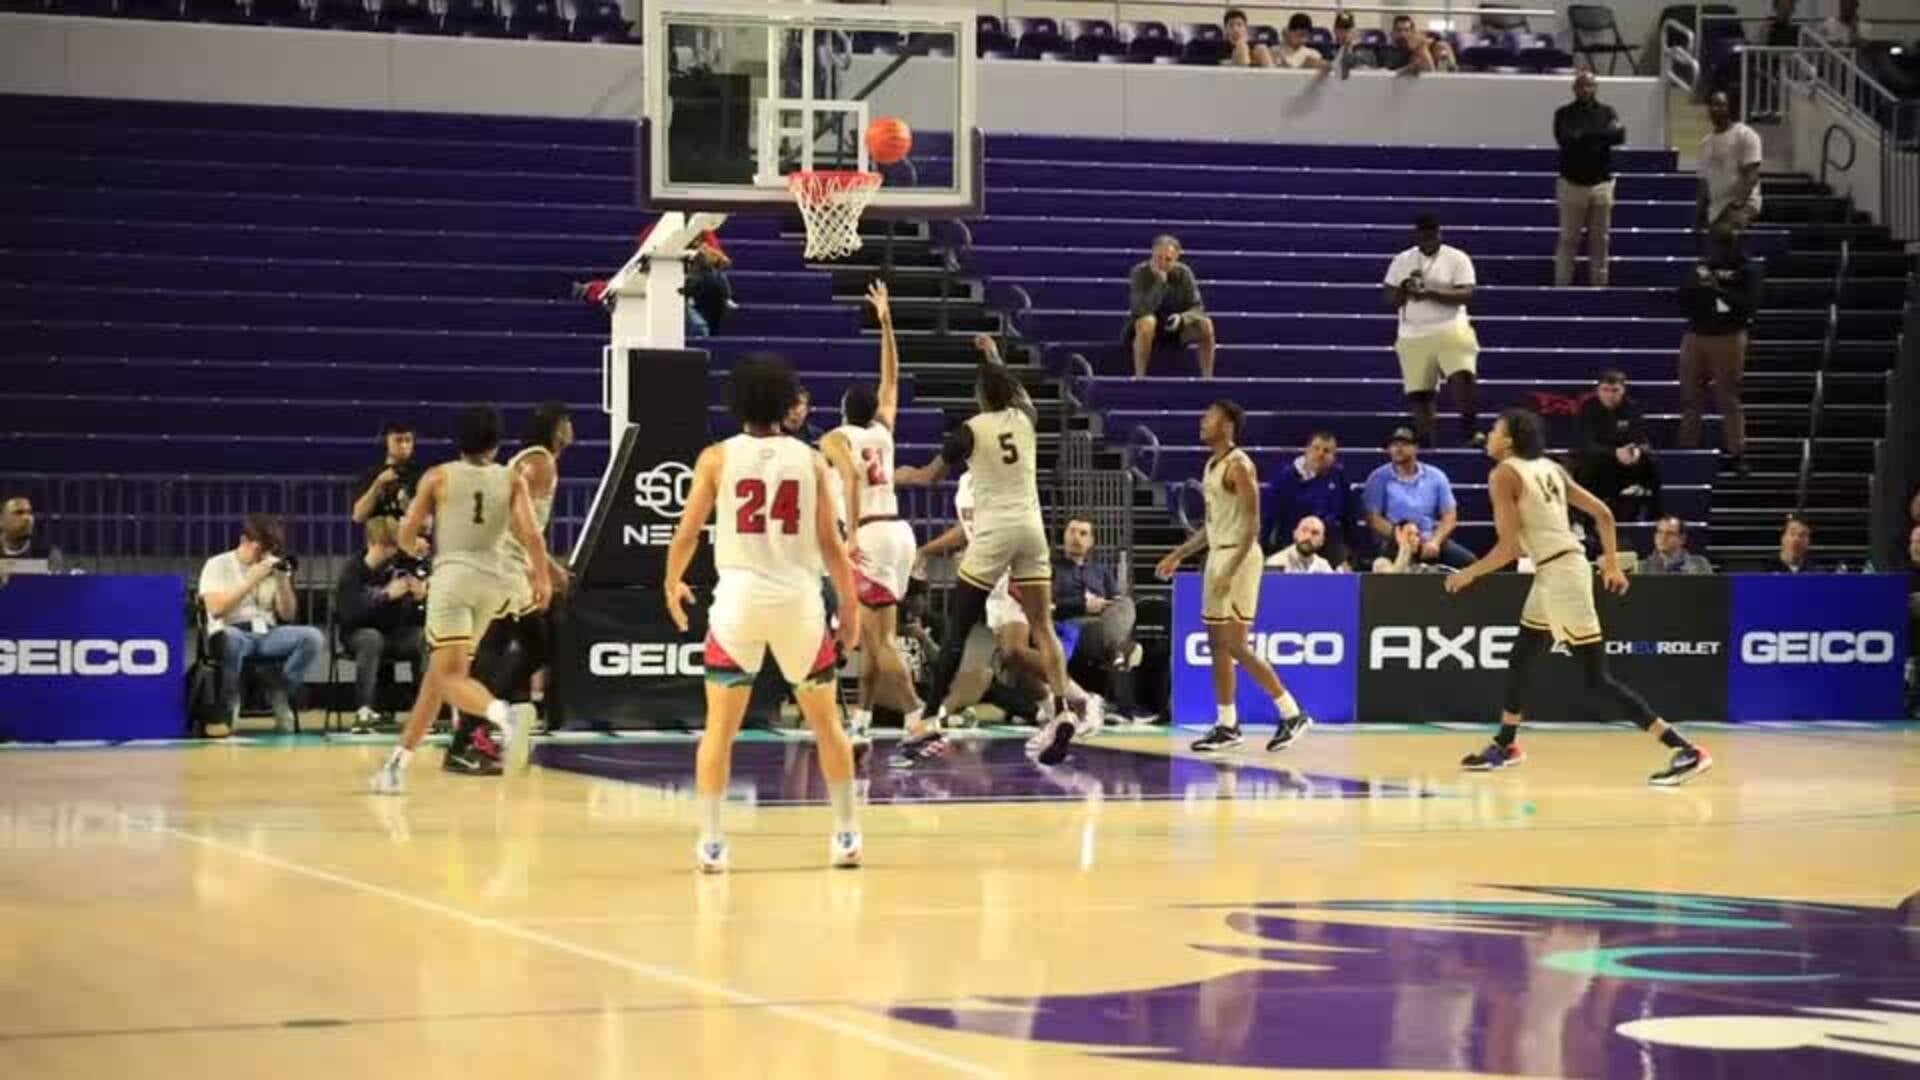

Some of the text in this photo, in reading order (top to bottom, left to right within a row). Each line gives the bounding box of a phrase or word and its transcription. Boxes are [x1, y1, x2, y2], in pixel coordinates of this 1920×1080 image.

[998, 433, 1019, 464] 5
[473, 490, 484, 525] 1
[735, 478, 801, 535] 24
[623, 524, 716, 545] NET
[589, 642, 705, 676] GEIC
[1185, 632, 1344, 665] GICO
[1369, 626, 1519, 669] AXE
[1741, 631, 1894, 663] GEICO
